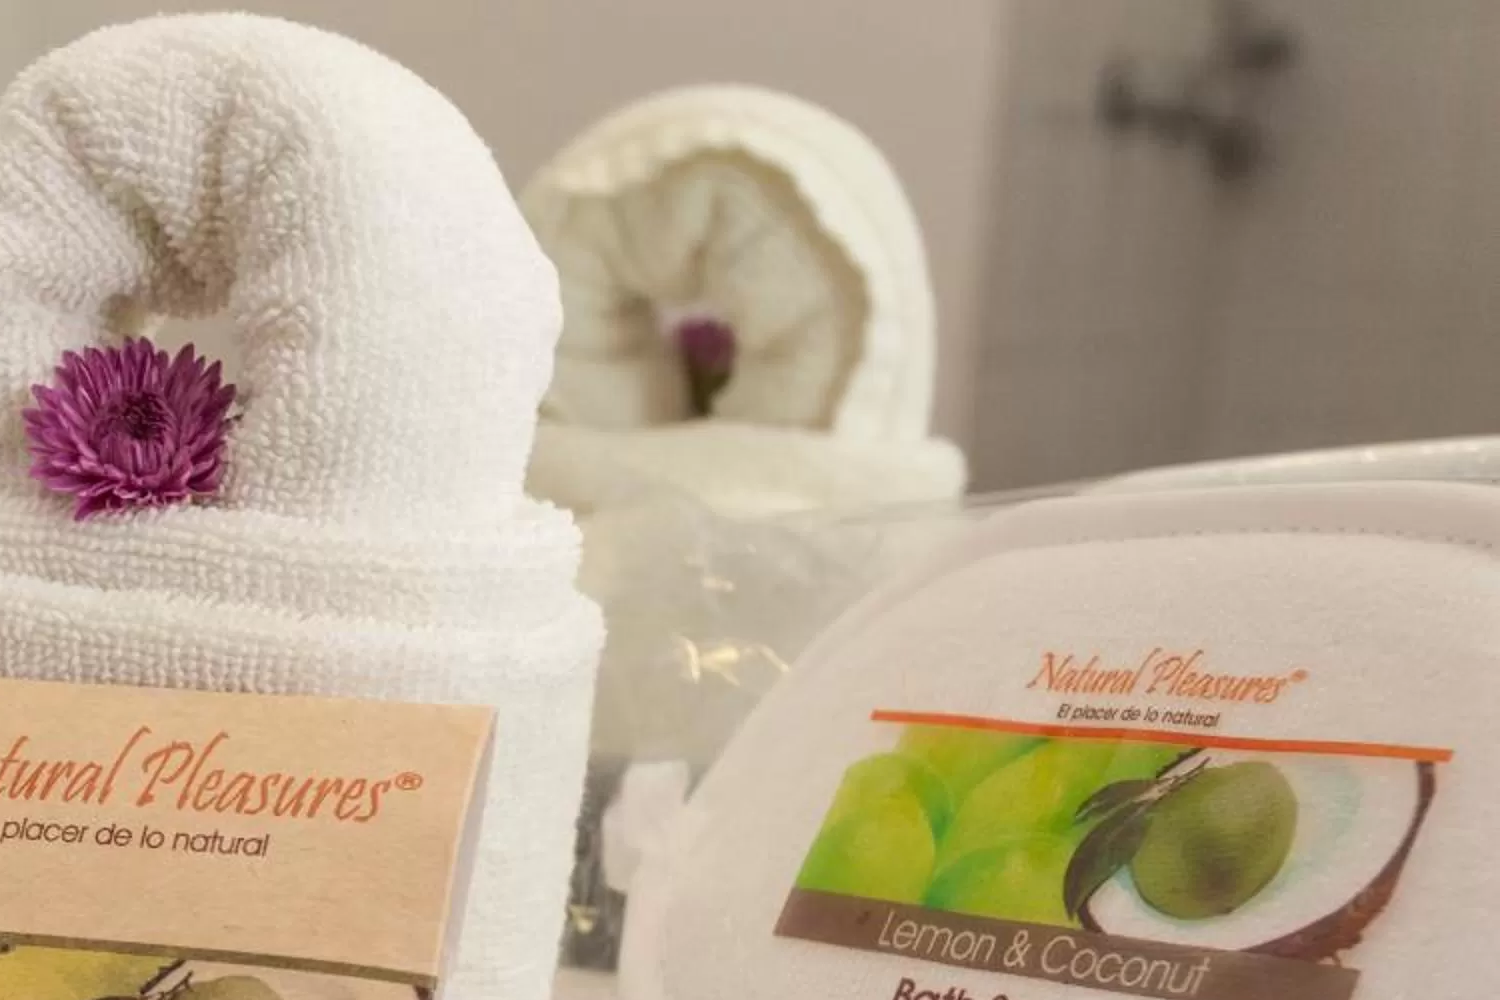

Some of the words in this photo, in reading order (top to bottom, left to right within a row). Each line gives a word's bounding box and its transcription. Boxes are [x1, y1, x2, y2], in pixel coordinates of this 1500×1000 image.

[1025, 647, 1162, 696] Natural
[1057, 703, 1071, 719] El
[1071, 705, 1117, 721] placer
[1120, 705, 1141, 721] de
[1146, 706, 1160, 723] lo
[1161, 709, 1221, 728] natural
[0, 816, 88, 845] placer
[95, 823, 134, 849] de
[140, 824, 166, 850] lo
[171, 829, 271, 858] natural
[877, 910, 997, 963] Lemon
[1003, 930, 1032, 969] &
[1040, 935, 1213, 995] Coconut
